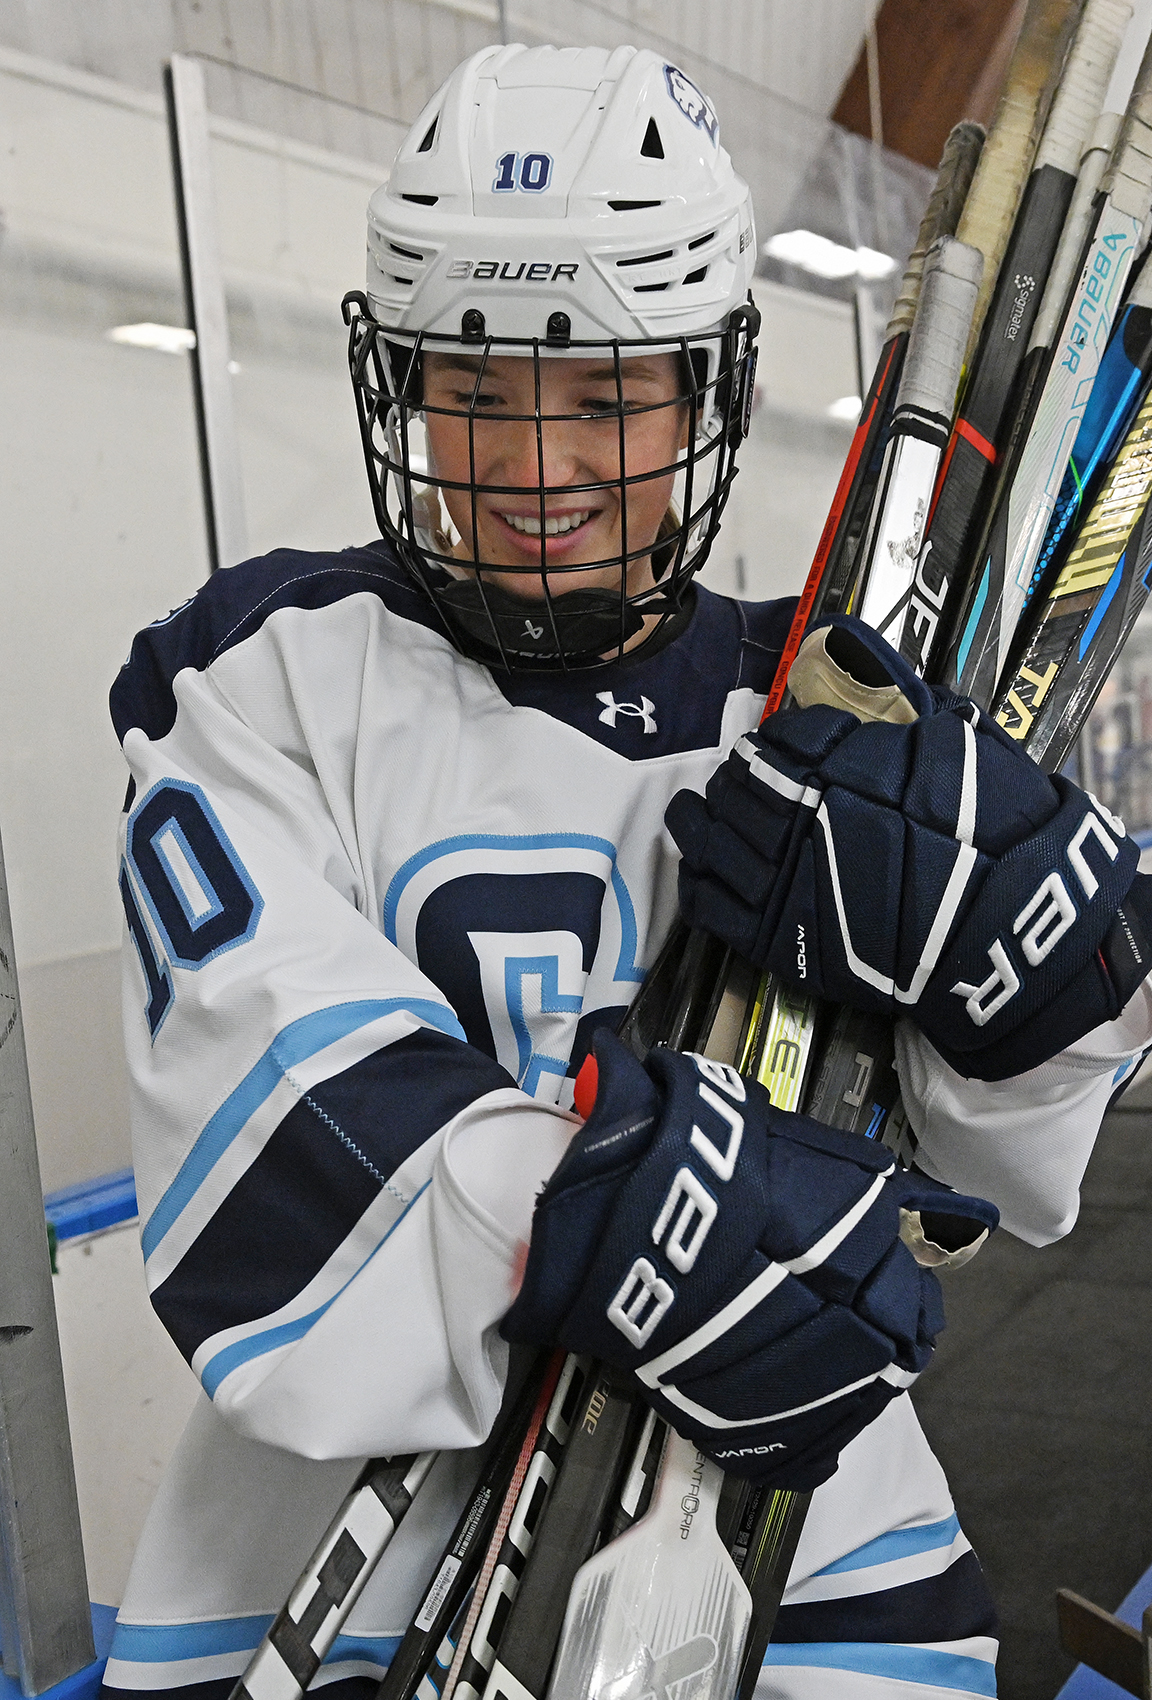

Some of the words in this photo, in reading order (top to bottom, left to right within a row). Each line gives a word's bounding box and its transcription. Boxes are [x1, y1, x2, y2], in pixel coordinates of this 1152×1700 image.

[492, 151, 554, 194] 10
[446, 260, 580, 281] BAUER
[1006, 289, 1030, 341] sigmatex
[1061, 250, 1112, 375] BAUER
[811, 566, 821, 581] FOR
[798, 592, 813, 615] QUICK
[788, 619, 804, 652] RELEASE
[766, 692, 779, 715] POUR
[118, 776, 265, 1048] 10
[949, 790, 1126, 1027] UER
[1124, 927, 1143, 964] PROTECTION
[607, 1050, 746, 1349] BAUE
[715, 1442, 788, 1459] VAPOR
[680, 1451, 706, 1540] ENTAGRIP
